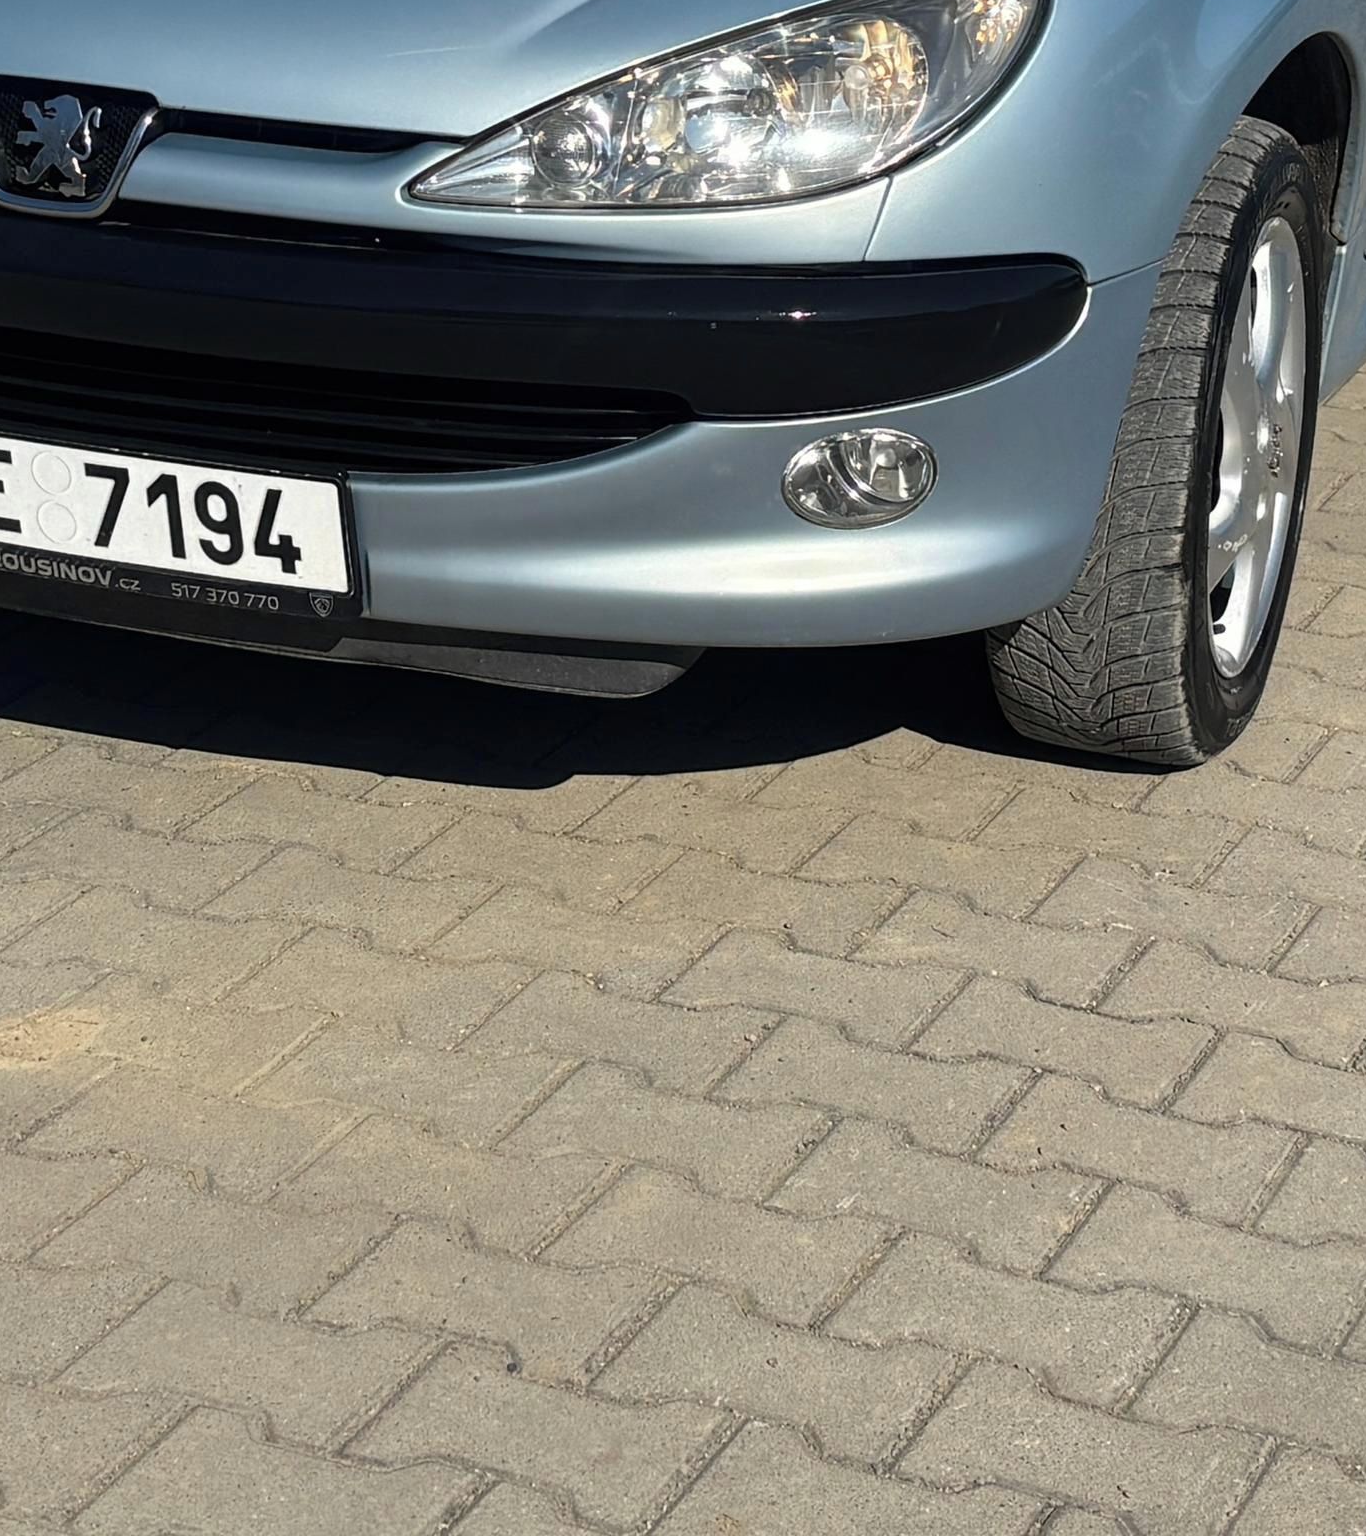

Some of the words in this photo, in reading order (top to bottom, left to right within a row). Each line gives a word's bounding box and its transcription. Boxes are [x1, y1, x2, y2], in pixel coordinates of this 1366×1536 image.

[85, 462, 302, 575] 7194
[171, 581, 201, 601] 517
[206, 589, 240, 606] 370
[244, 593, 280, 611] 770
